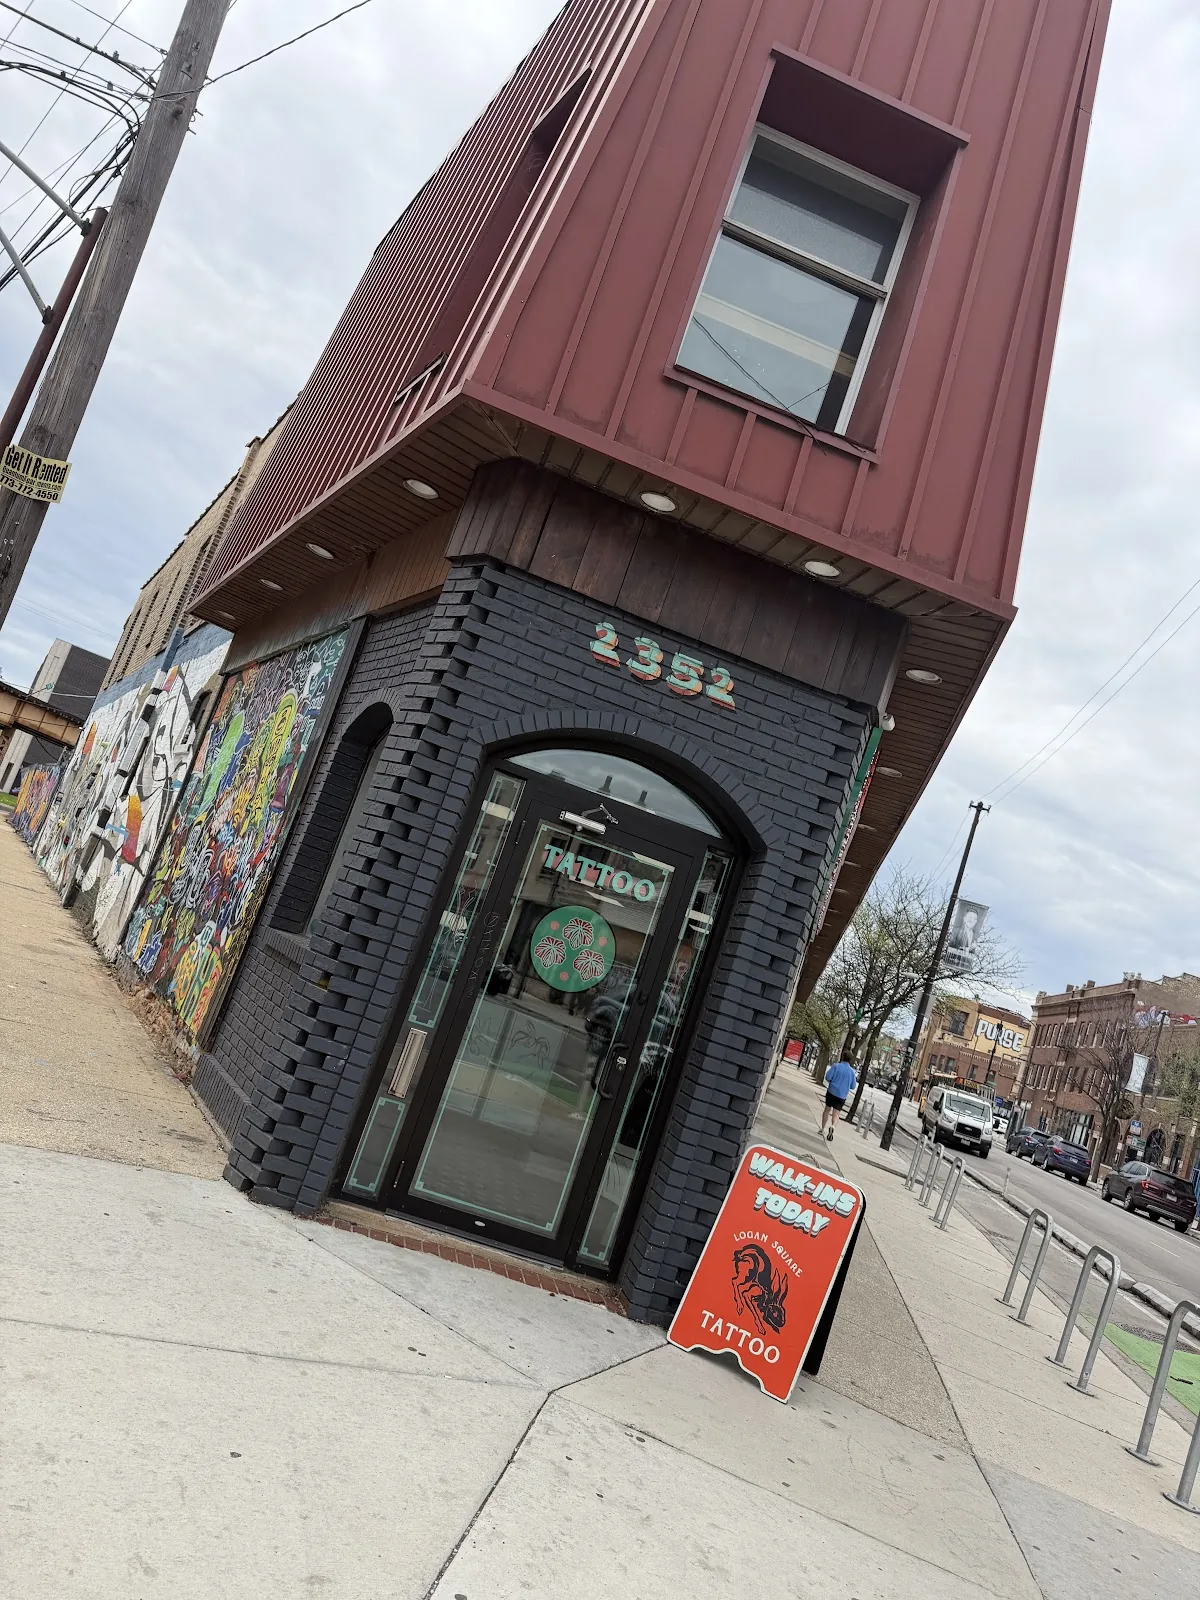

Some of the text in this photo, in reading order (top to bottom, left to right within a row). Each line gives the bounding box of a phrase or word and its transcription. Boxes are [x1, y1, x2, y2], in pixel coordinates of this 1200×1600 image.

[5, 445, 24, 471] Get
[31, 457, 69, 485] Rented
[589, 621, 737, 714] 2352
[544, 843, 655, 902] TATTOO
[748, 1151, 857, 1220] WALK-INS
[753, 1187, 831, 1239] TODAY
[733, 1230, 803, 1278] LOGAN SQUARE
[700, 1309, 781, 1364] TATTOO
